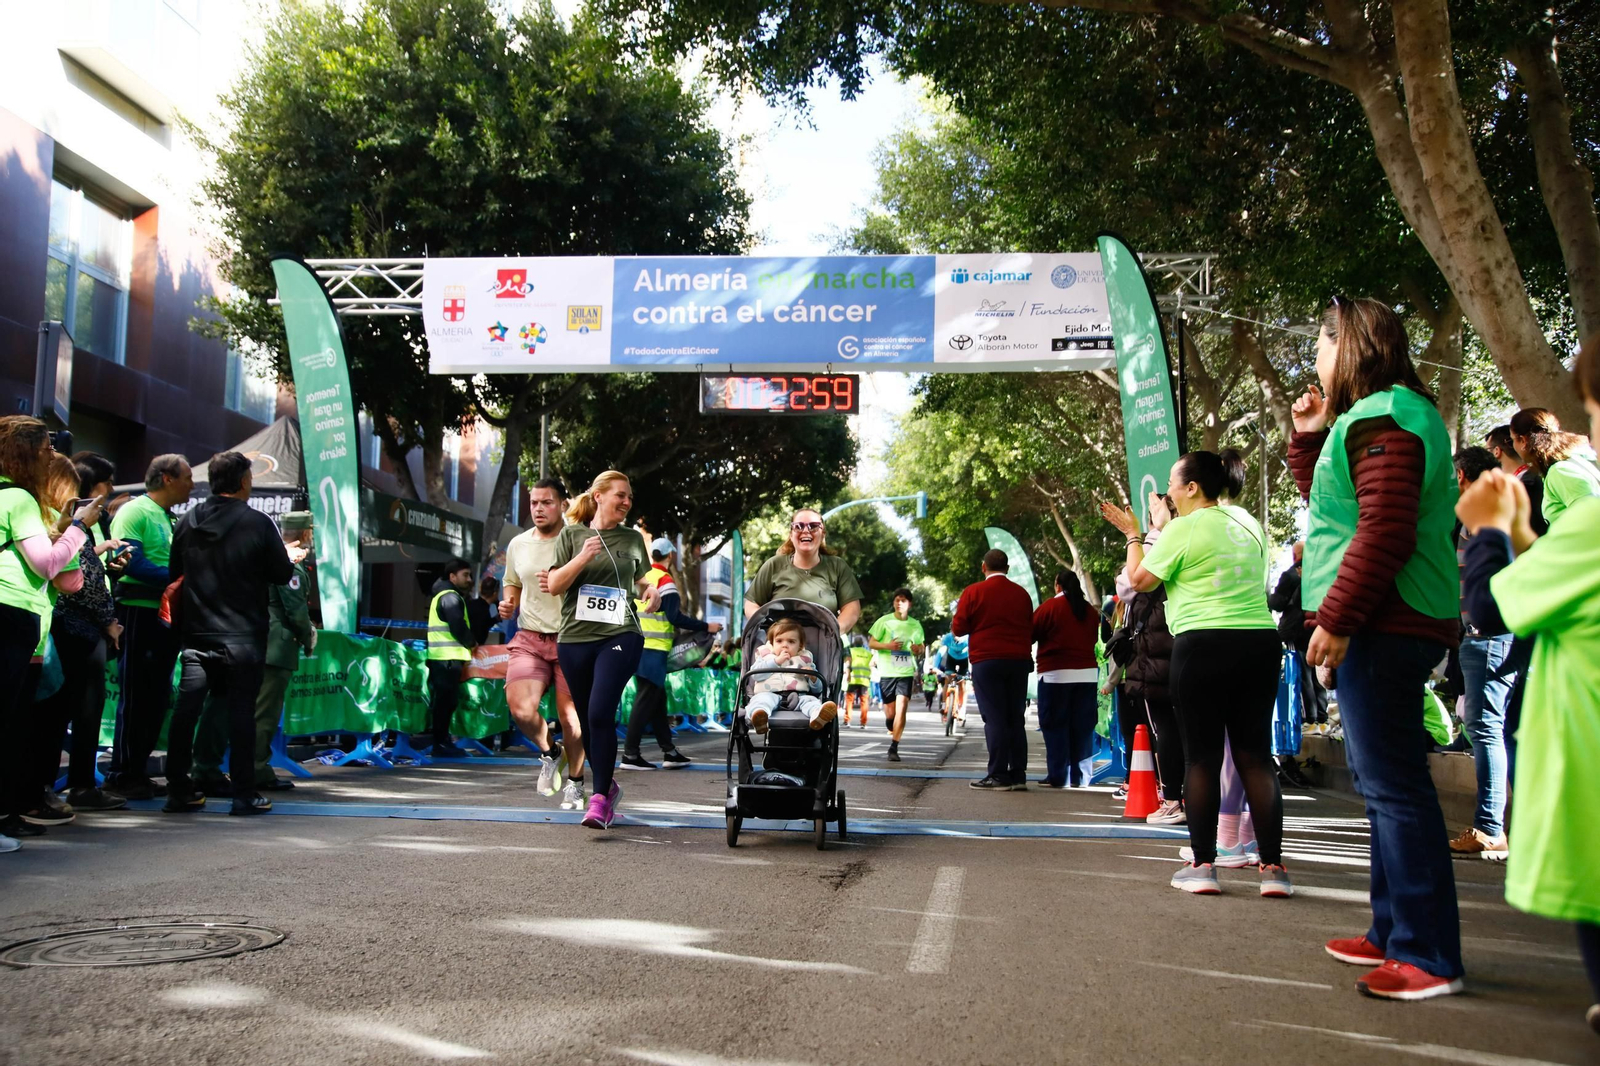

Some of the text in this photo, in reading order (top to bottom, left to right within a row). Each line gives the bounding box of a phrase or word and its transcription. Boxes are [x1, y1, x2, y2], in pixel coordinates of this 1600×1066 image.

[633, 266, 916, 292] Almería en marcha
[974, 268, 1032, 284] cajamar
[571, 308, 598, 318] SOLAN
[632, 300, 877, 324] contra el cáncer
[1030, 302, 1098, 316] Fundación
[432, 326, 472, 337] ALMERÍA
[1065, 324, 1088, 335] Ejido
[624, 346, 720, 355] #TodosContraElCáncer
[978, 342, 1011, 351] Alborán
[1098, 341, 1108, 349] FIAT
[587, 597, 617, 612] 589
